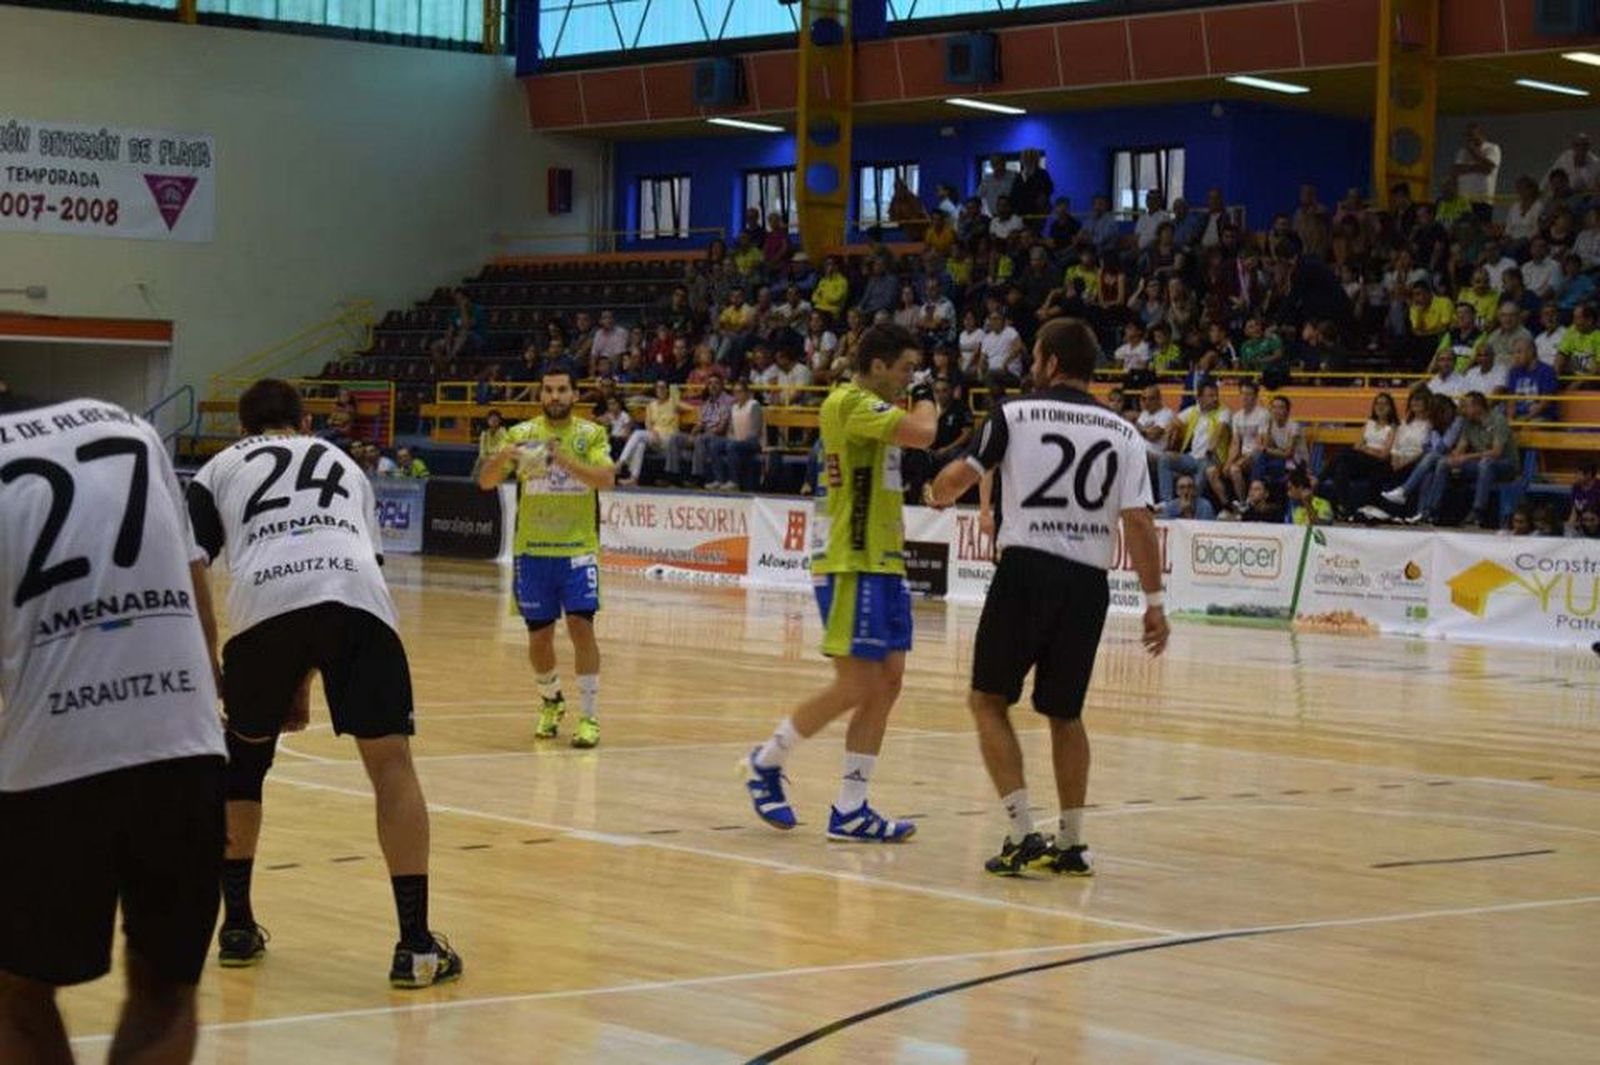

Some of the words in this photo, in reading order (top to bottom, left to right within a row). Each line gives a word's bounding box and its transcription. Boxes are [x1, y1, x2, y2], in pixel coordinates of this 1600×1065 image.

[128, 137, 152, 164] DE
[159, 139, 211, 168] PLATA
[6, 165, 100, 188] TEMPORADA
[16, 420, 51, 440] DE
[1015, 408, 1028, 423] J.
[242, 444, 350, 523] 24
[1021, 433, 1119, 512] 20
[1, 436, 150, 608] 27
[665, 506, 748, 534] ASESORIA
[758, 552, 803, 570] Alonso
[1196, 539, 1277, 567] biocicer
[253, 557, 325, 586] ZARAUTZ
[328, 557, 360, 573] K.E.
[36, 589, 191, 637] AMENABAR
[49, 673, 155, 716] ZARAUTZ
[160, 669, 196, 695] K.E.
